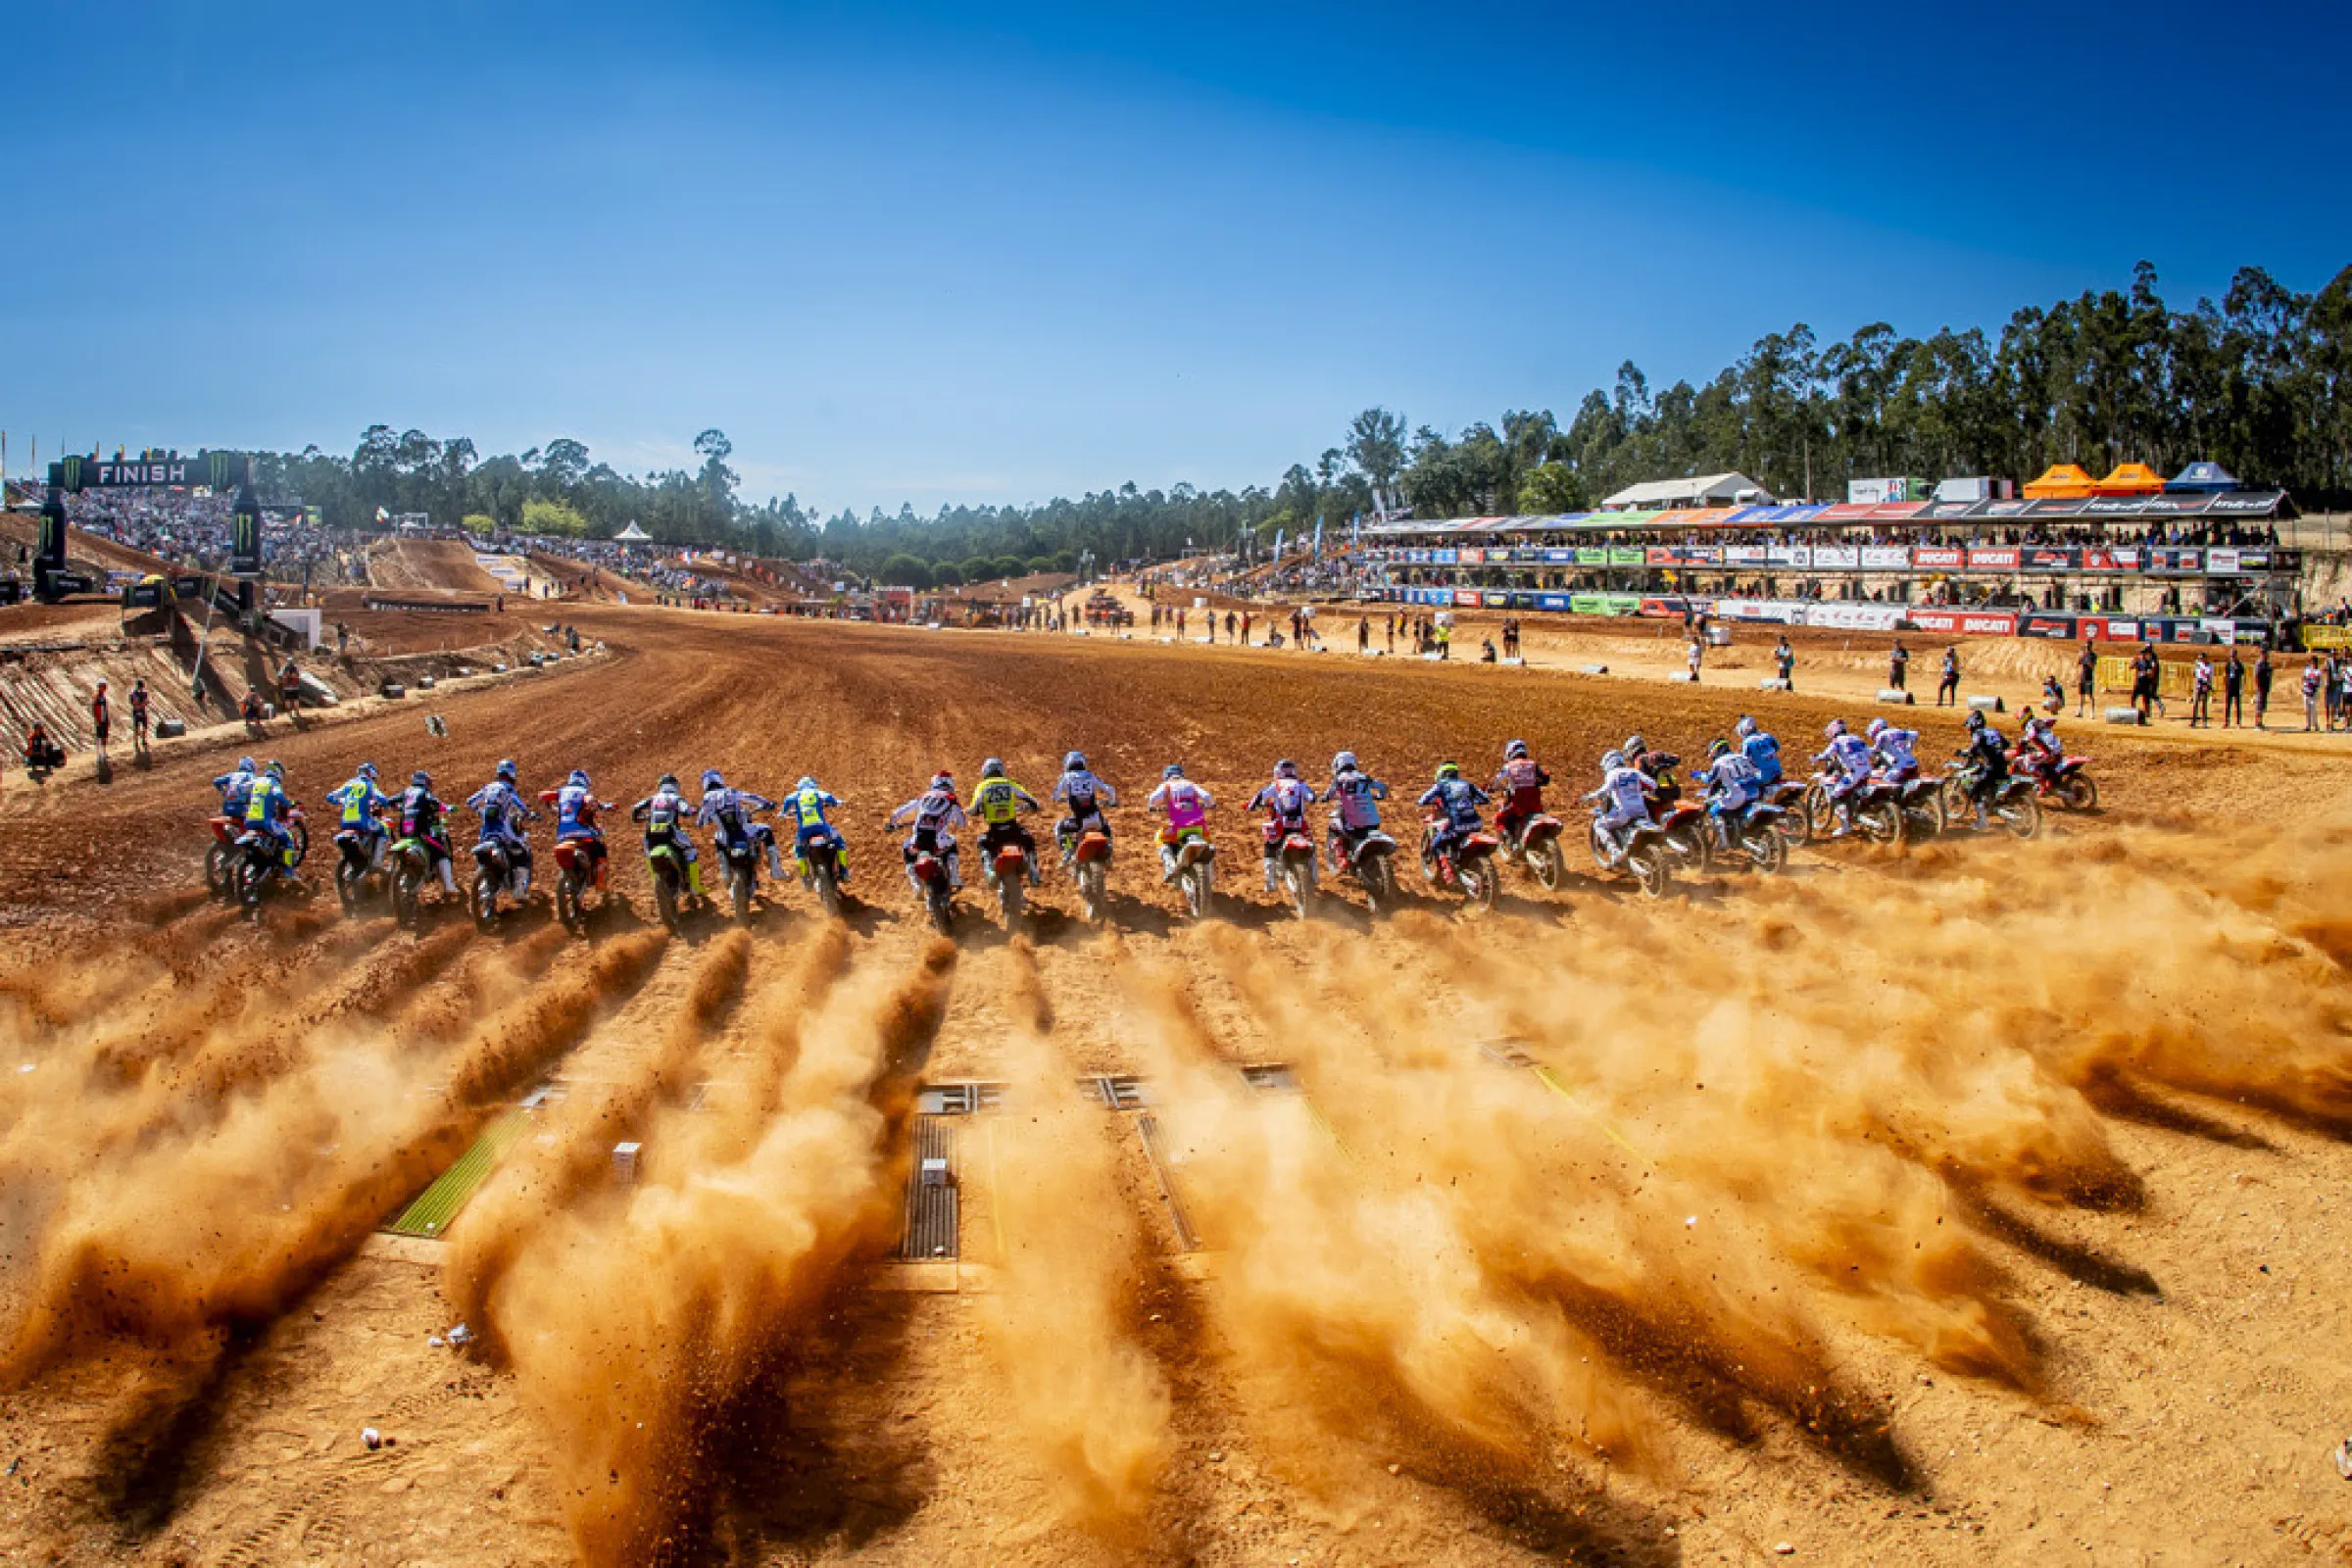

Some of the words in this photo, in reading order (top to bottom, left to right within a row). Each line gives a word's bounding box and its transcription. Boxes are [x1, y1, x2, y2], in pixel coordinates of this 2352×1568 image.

[100, 465, 185, 483] FINISH
[1917, 552, 1958, 564] DUCATI
[1972, 553, 2014, 564] DUCATI
[1964, 617, 2010, 633] DUCATI
